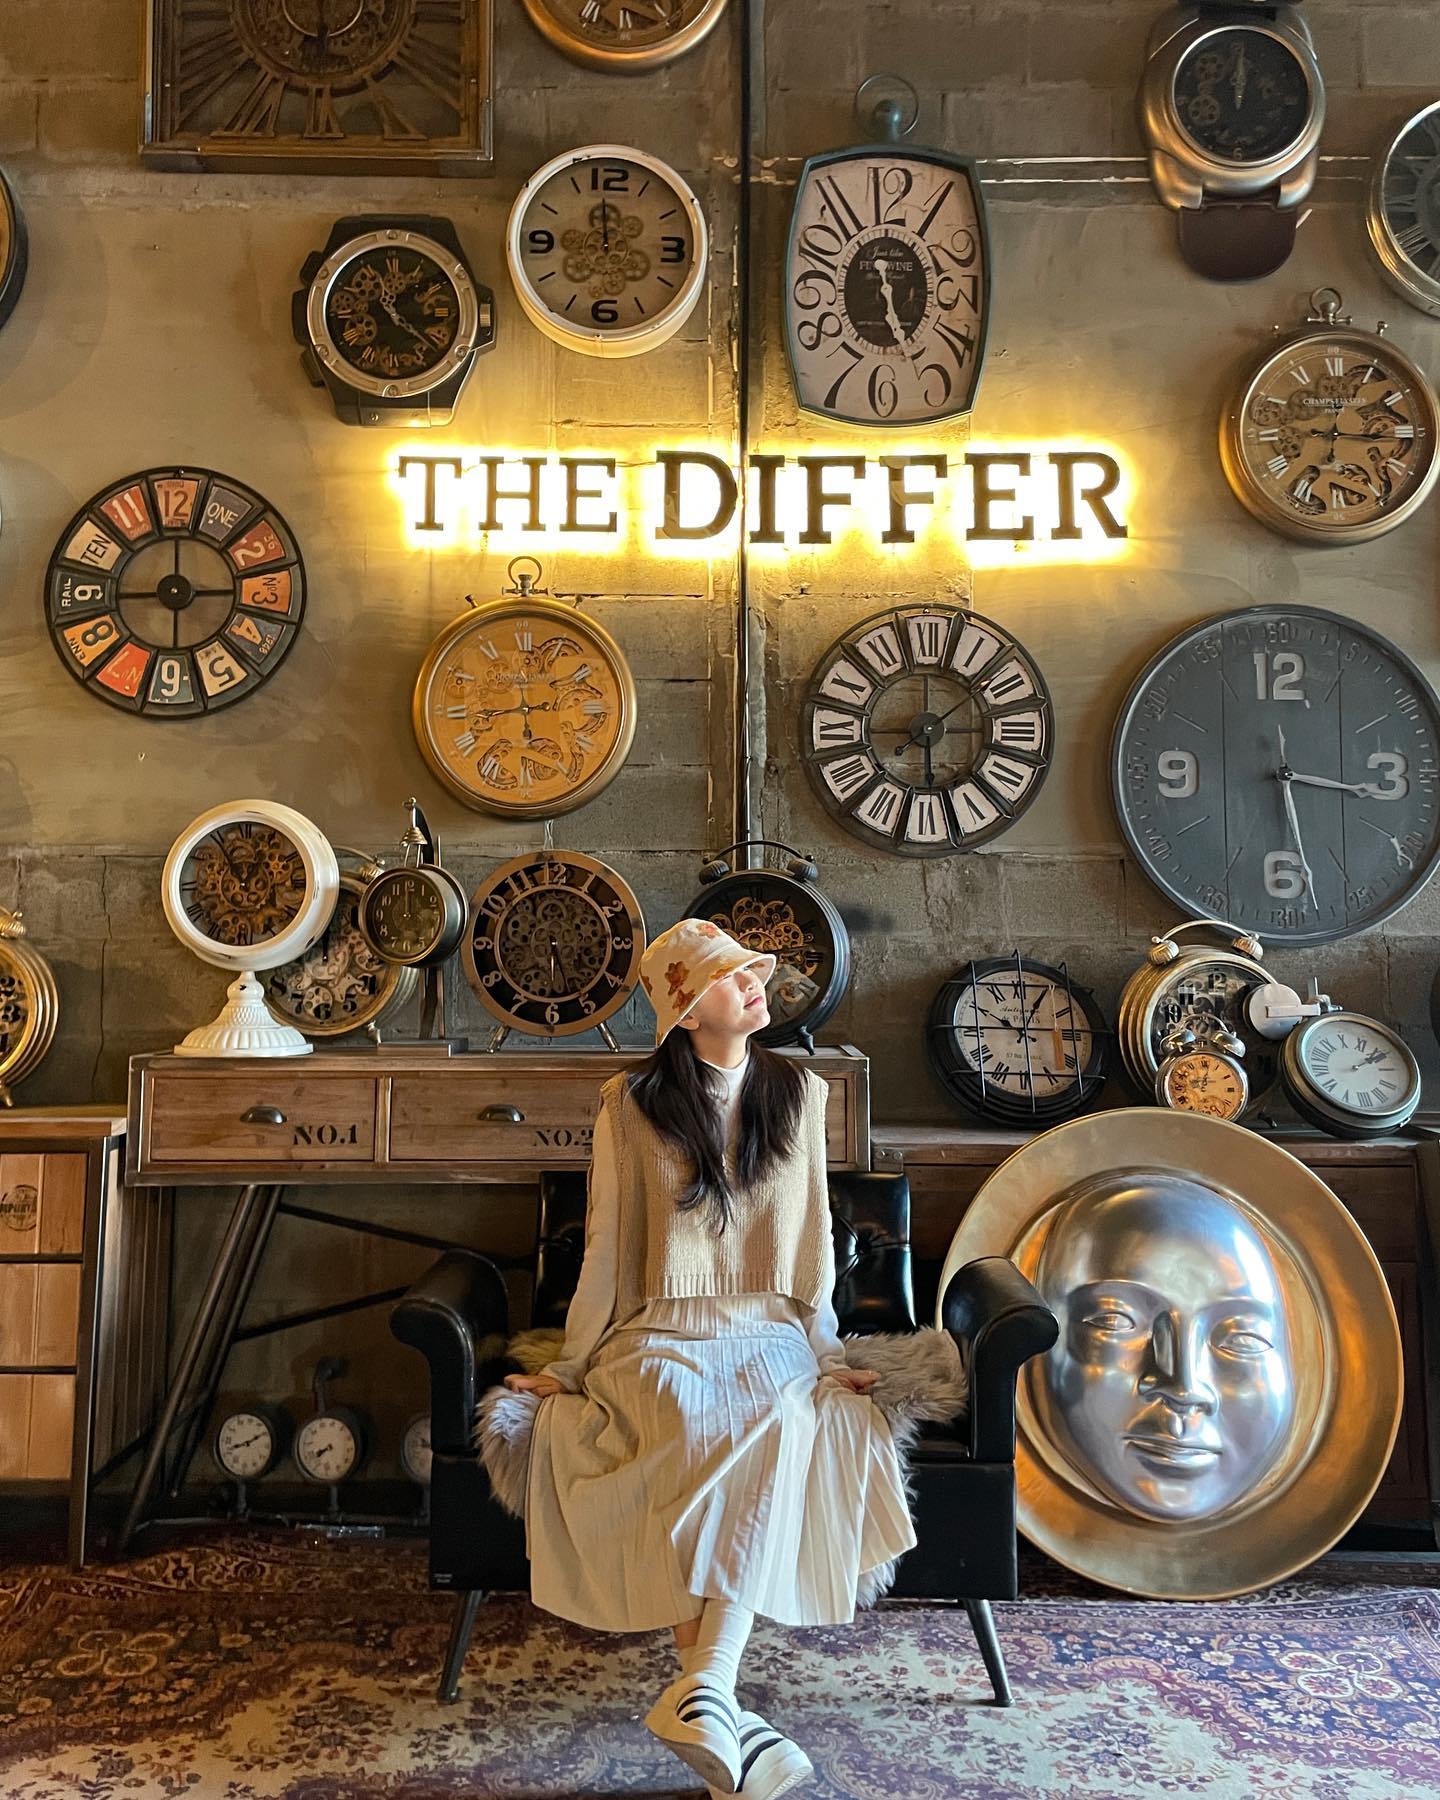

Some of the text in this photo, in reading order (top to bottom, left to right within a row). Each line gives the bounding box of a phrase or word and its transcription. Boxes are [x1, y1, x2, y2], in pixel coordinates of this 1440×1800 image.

[591, 168, 629, 192] 12
[866, 167, 913, 227] 12
[815, 175, 868, 246] 11
[912, 180, 955, 241] 1
[528, 230, 554, 254] 9
[660, 236, 686, 263] 3
[799, 224, 842, 277] 10
[927, 229, 976, 278] 2
[886, 261, 913, 271] WINE
[794, 270, 837, 310] 9
[937, 275, 978, 314] 3
[591, 300, 619, 323] 6
[797, 312, 842, 351] 8
[932, 314, 976, 369] 4
[824, 341, 864, 409] 7
[911, 347, 952, 407] 5
[868, 364, 898, 418] 6
[1394, 425, 1414, 438] III
[164, 490, 189, 518] 12
[398, 449, 1129, 544] THE DIFFER
[112, 493, 144, 529] 11
[207, 501, 239, 529] ONE
[80, 534, 112, 565] TEN
[234, 541, 266, 567] 2
[61, 578, 72, 607] RAIL
[74, 584, 104, 601] 9
[251, 591, 279, 606] 3
[81, 620, 114, 647] 8
[230, 617, 263, 646] 4
[916, 622, 941, 658] XII
[1265, 622, 1290, 643] 60
[69, 637, 86, 661] ENN
[866, 634, 899, 672] XI
[963, 636, 985, 668] I
[107, 651, 130, 679] 7
[208, 656, 235, 687] 5
[1253, 652, 1305, 701] 12
[831, 672, 866, 700] X
[989, 672, 1026, 699] II
[819, 719, 854, 741] IX
[1001, 721, 1035, 742] III
[830, 757, 871, 794] VIII
[989, 760, 1025, 794] IV
[1158, 750, 1198, 798] 9
[1367, 752, 1408, 800] 3
[868, 788, 898, 825] VII
[918, 801, 936, 836] VI
[962, 792, 986, 825] V
[505, 871, 535, 897] 11
[543, 863, 568, 887] 12
[580, 873, 597, 894] 1
[1264, 850, 1306, 899] 6
[381, 896, 391, 907] 10
[392, 884, 400, 896] 11
[421, 884, 425, 897] 1
[429, 895, 437, 908] 2
[1349, 886, 1375, 913] 25
[376, 909, 384, 920] 9
[481, 894, 507, 919] 10
[602, 900, 624, 919] 2
[380, 924, 388, 937] 8
[1275, 909, 1300, 929] 30
[391, 936, 398, 948] 7
[402, 940, 411, 952] 6
[473, 936, 495, 951] 9
[611, 936, 633, 951] 3
[482, 971, 502, 988] 8
[603, 971, 625, 989] 4
[1012, 980, 1027, 999] XII
[343, 993, 357, 1013] 5
[510, 994, 529, 1015] 7
[579, 993, 597, 1015] 5
[987, 984, 1006, 1004] XI
[313, 1003, 331, 1020] 6
[545, 1003, 560, 1025] 6
[1321, 1037, 1337, 1053] IX
[1337, 1034, 1348, 1049] X
[1354, 1036, 1367, 1053] XI
[1311, 1064, 1329, 1077] VII
[1321, 1079, 1338, 1093] VI
[1342, 1089, 1349, 1103] V
[1371, 1087, 1389, 1104] III
[1379, 1079, 1397, 1091] II
[1356, 1091, 1373, 1107] IIII
[293, 1125, 359, 1146] NO.1
[533, 1128, 595, 1148] NO.2
